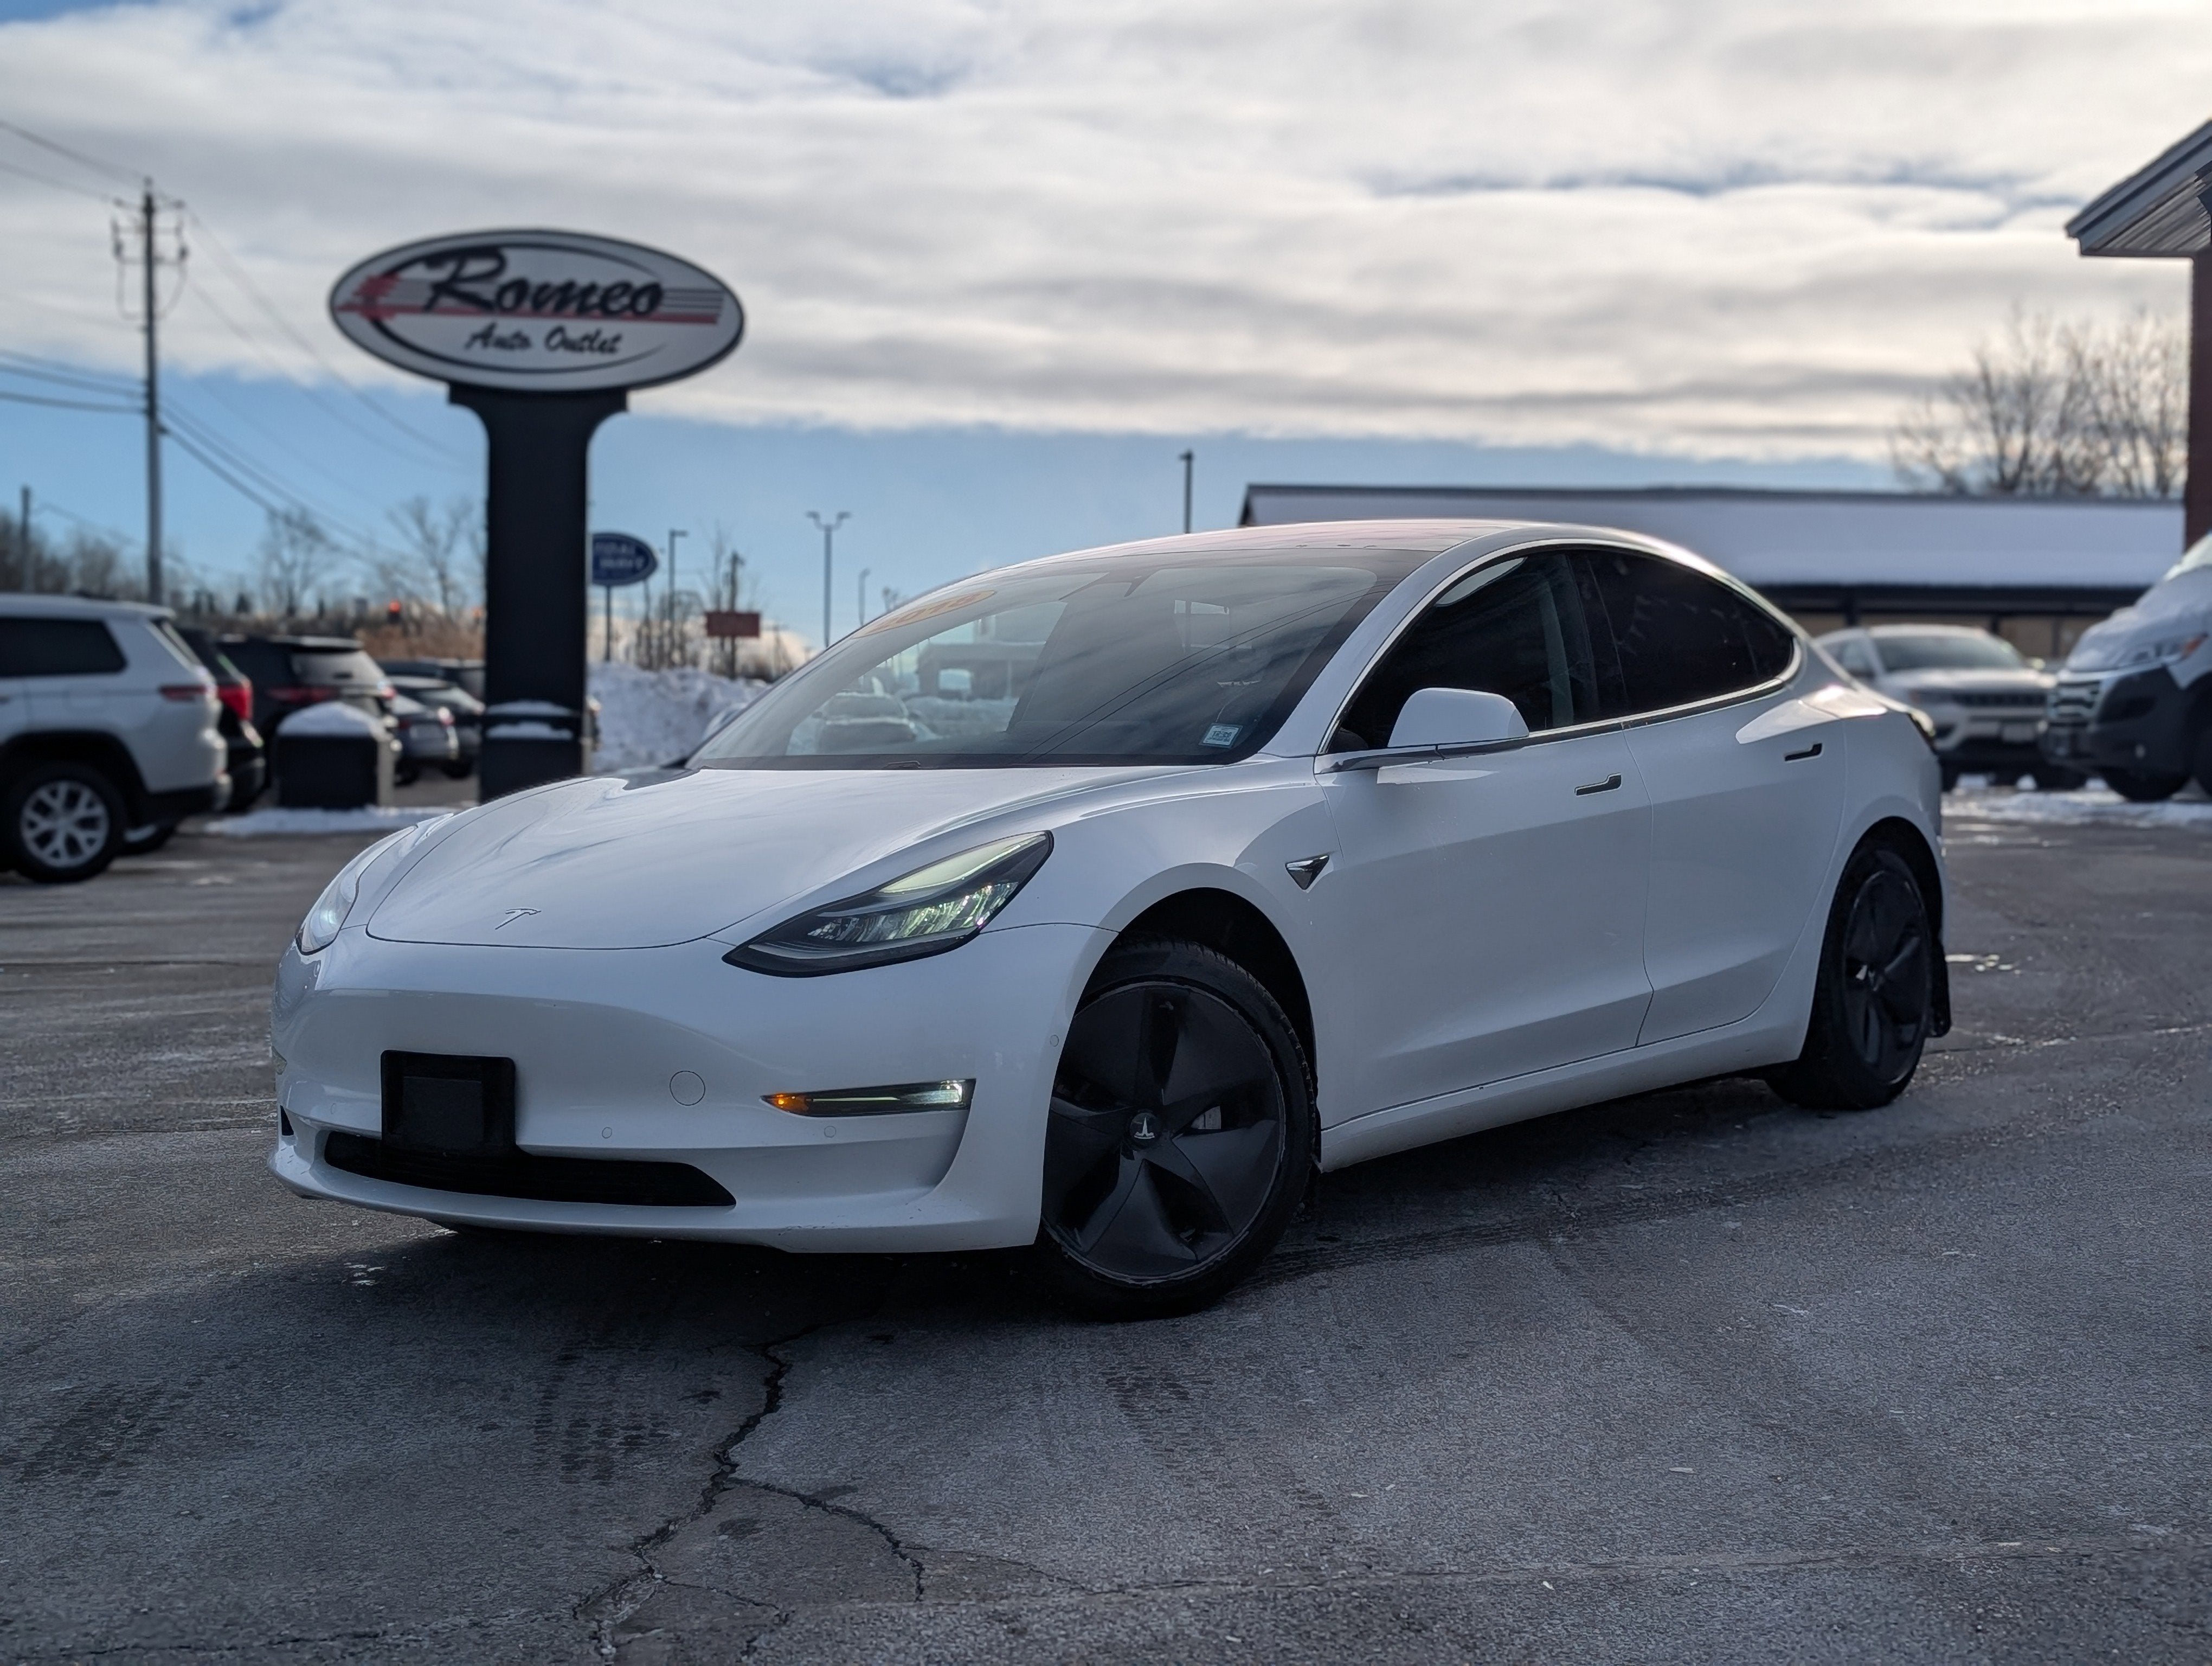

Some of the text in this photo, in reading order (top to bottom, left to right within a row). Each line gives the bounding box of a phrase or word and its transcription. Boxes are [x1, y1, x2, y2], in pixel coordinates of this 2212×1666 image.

[422, 246, 663, 316] Romeo
[464, 322, 622, 354] Auto Outlet
